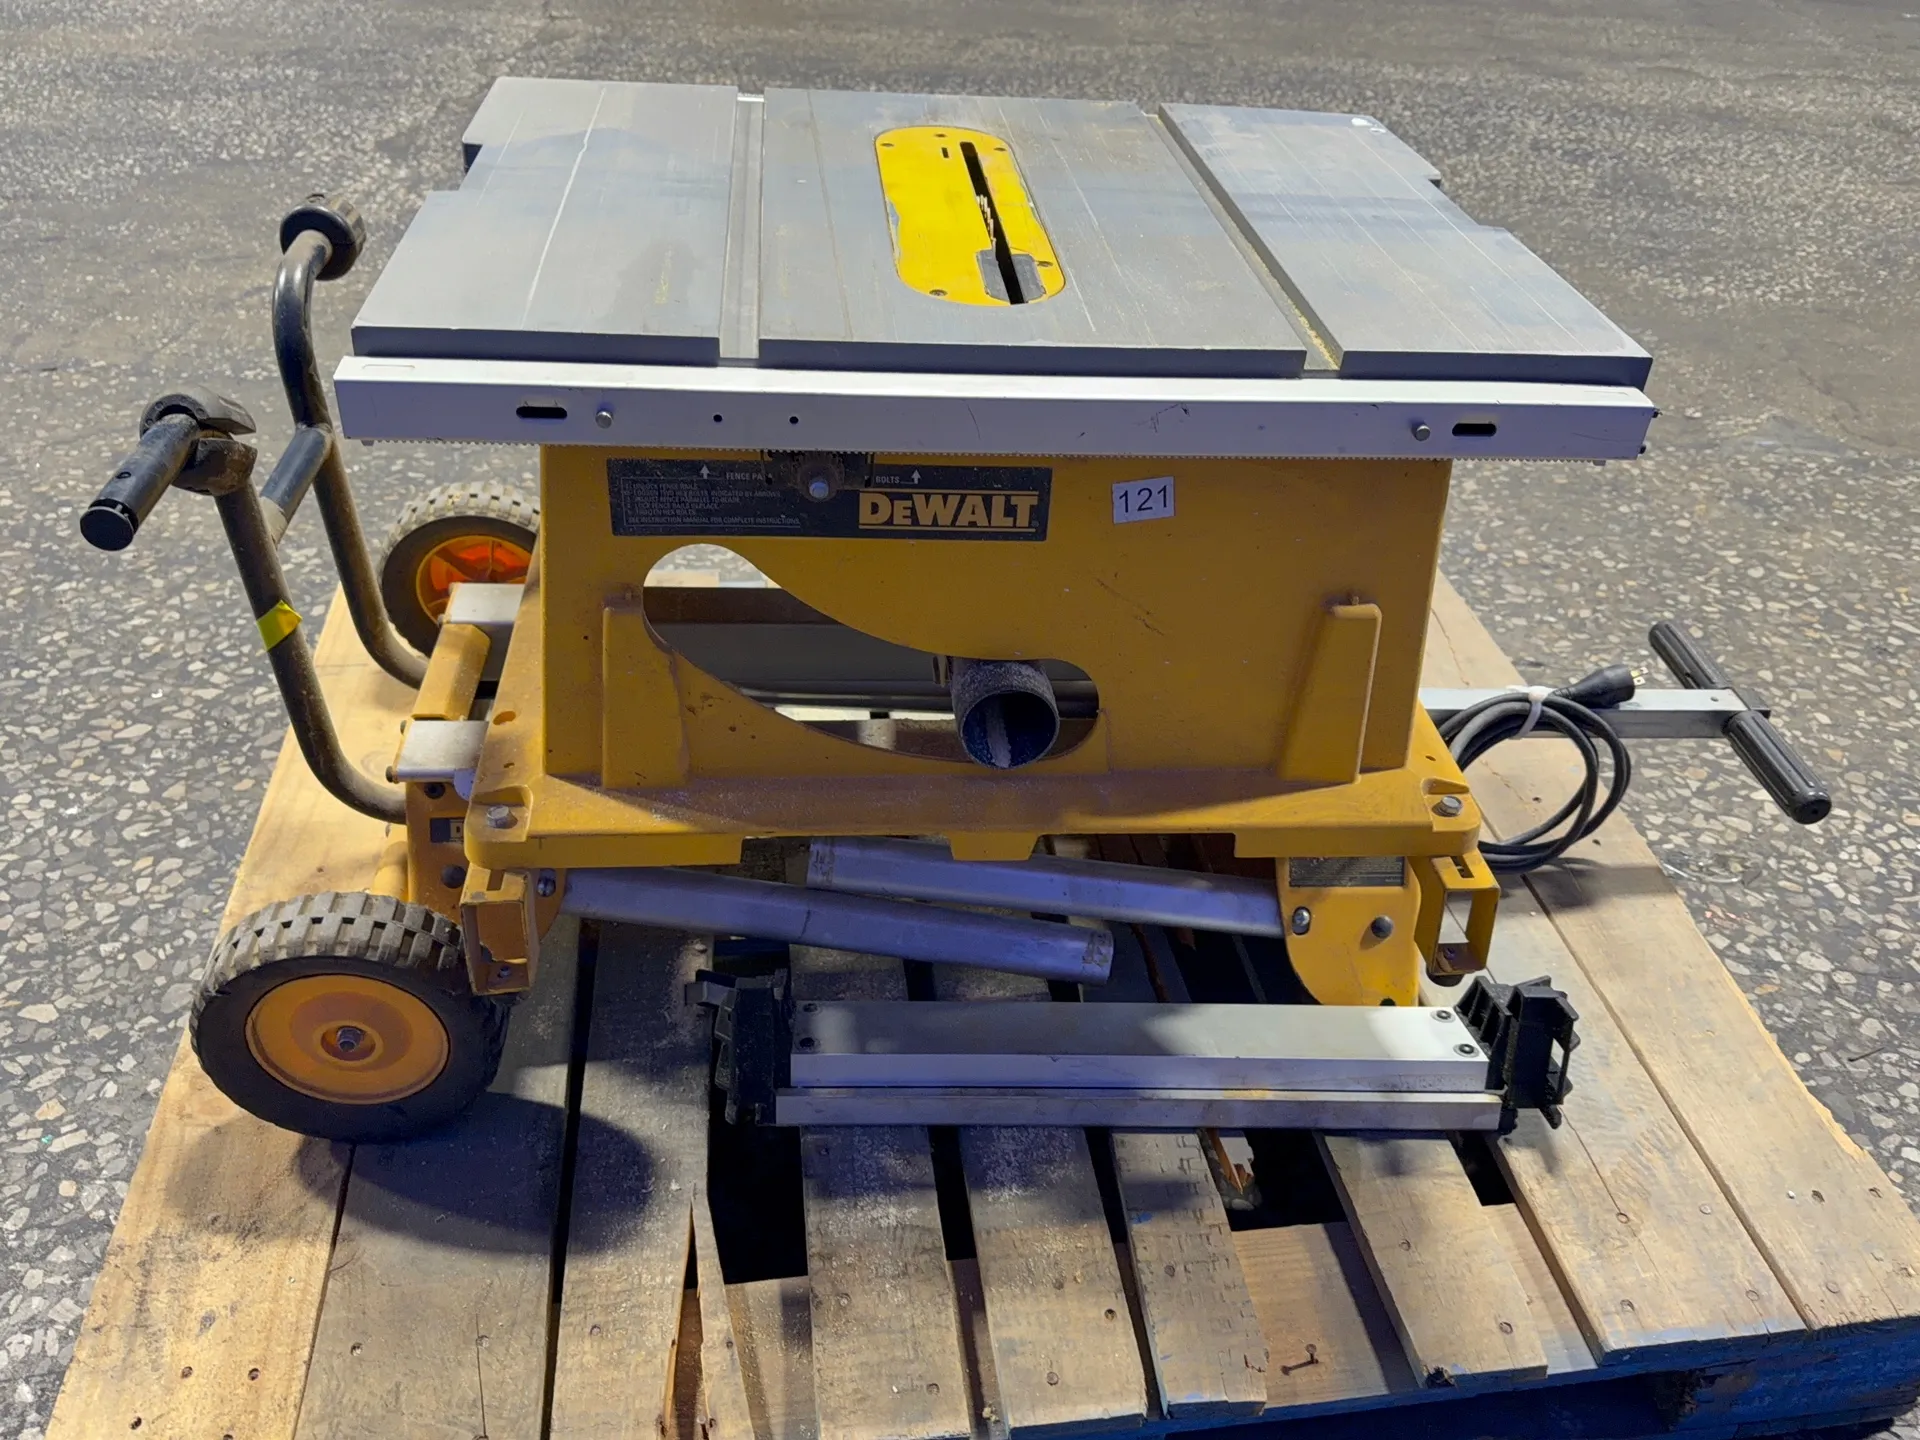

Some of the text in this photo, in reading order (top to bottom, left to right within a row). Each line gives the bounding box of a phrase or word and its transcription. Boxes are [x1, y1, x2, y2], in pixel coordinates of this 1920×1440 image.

[726, 472, 750, 480] FENCE
[875, 475, 900, 483] BOLTS
[1117, 484, 1173, 514] 121
